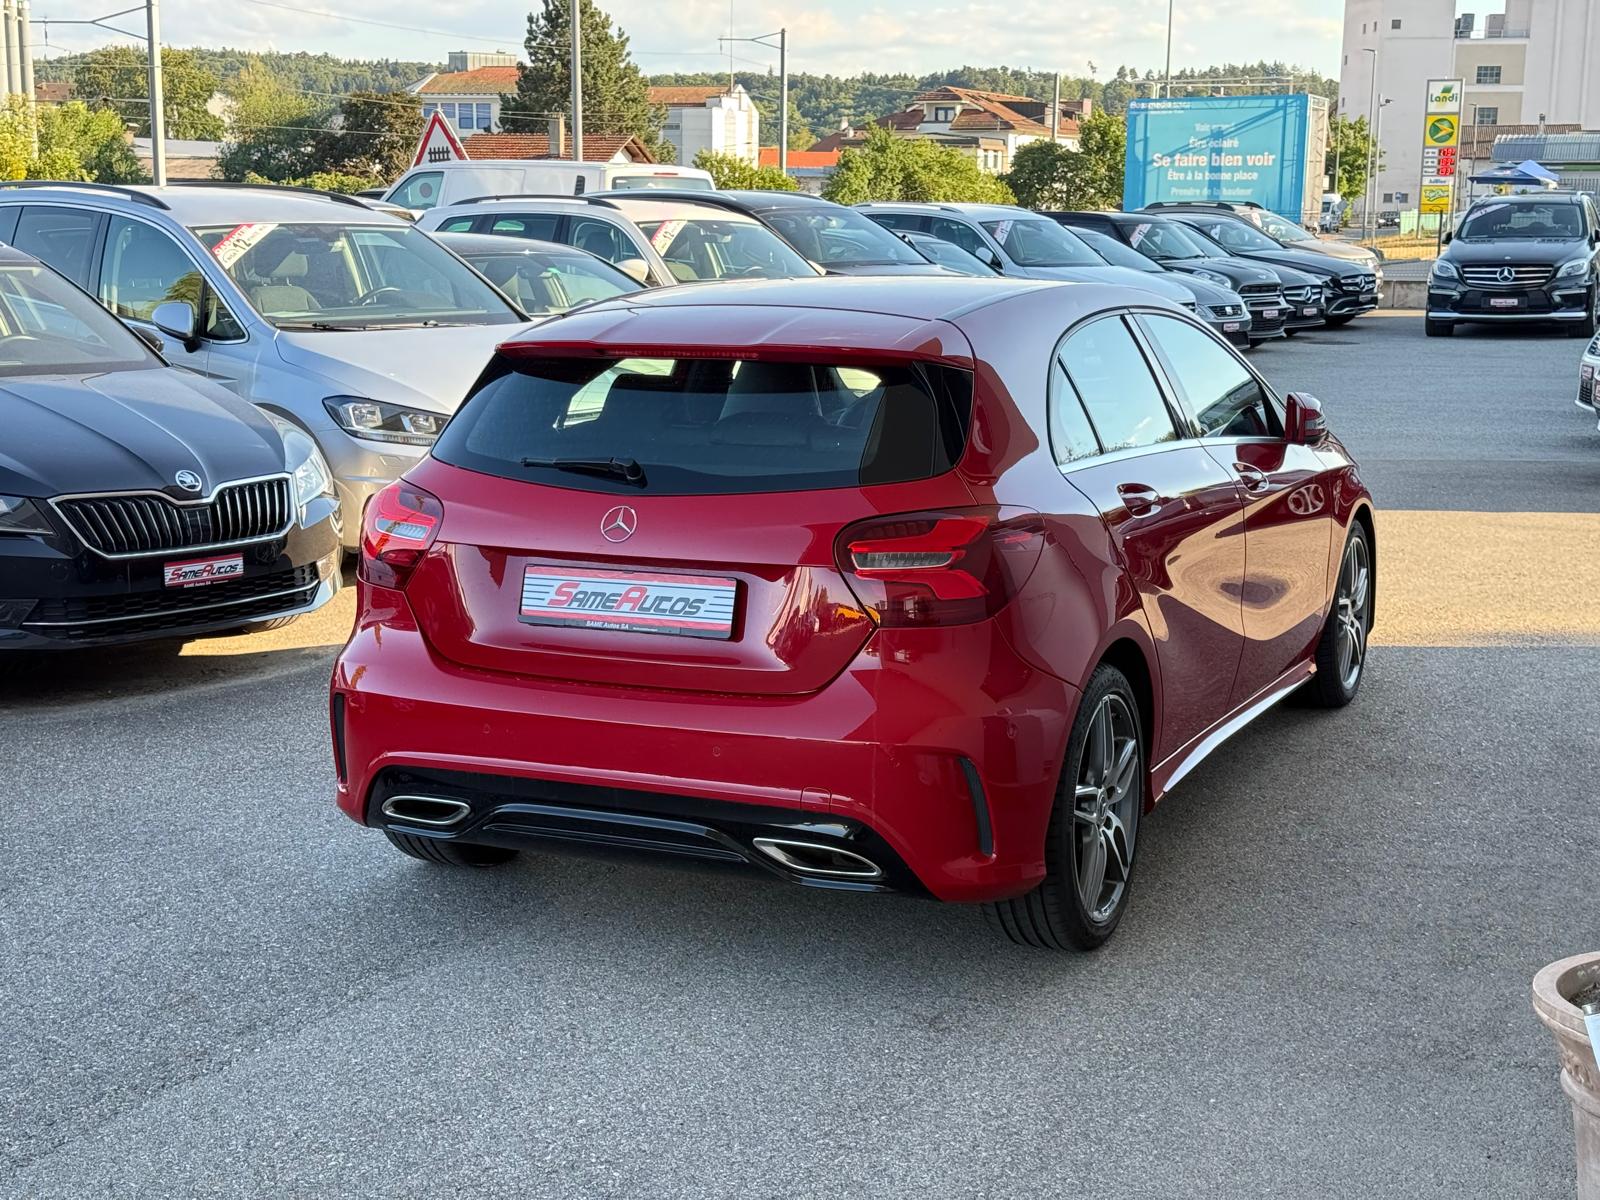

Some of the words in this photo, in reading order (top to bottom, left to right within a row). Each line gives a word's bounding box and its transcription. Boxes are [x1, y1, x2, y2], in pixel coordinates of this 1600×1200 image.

[1430, 94, 1458, 103] Landi
[1152, 153, 1171, 167] Se
[1174, 153, 1207, 167] faire
[1211, 153, 1243, 167] bien
[1246, 152, 1276, 167] voir
[1167, 168, 1185, 181] Être
[1186, 170, 1193, 181] à
[1194, 170, 1203, 181] la
[1204, 170, 1232, 181] bonne
[1233, 170, 1259, 182] place
[586, 620, 604, 629] SAME
